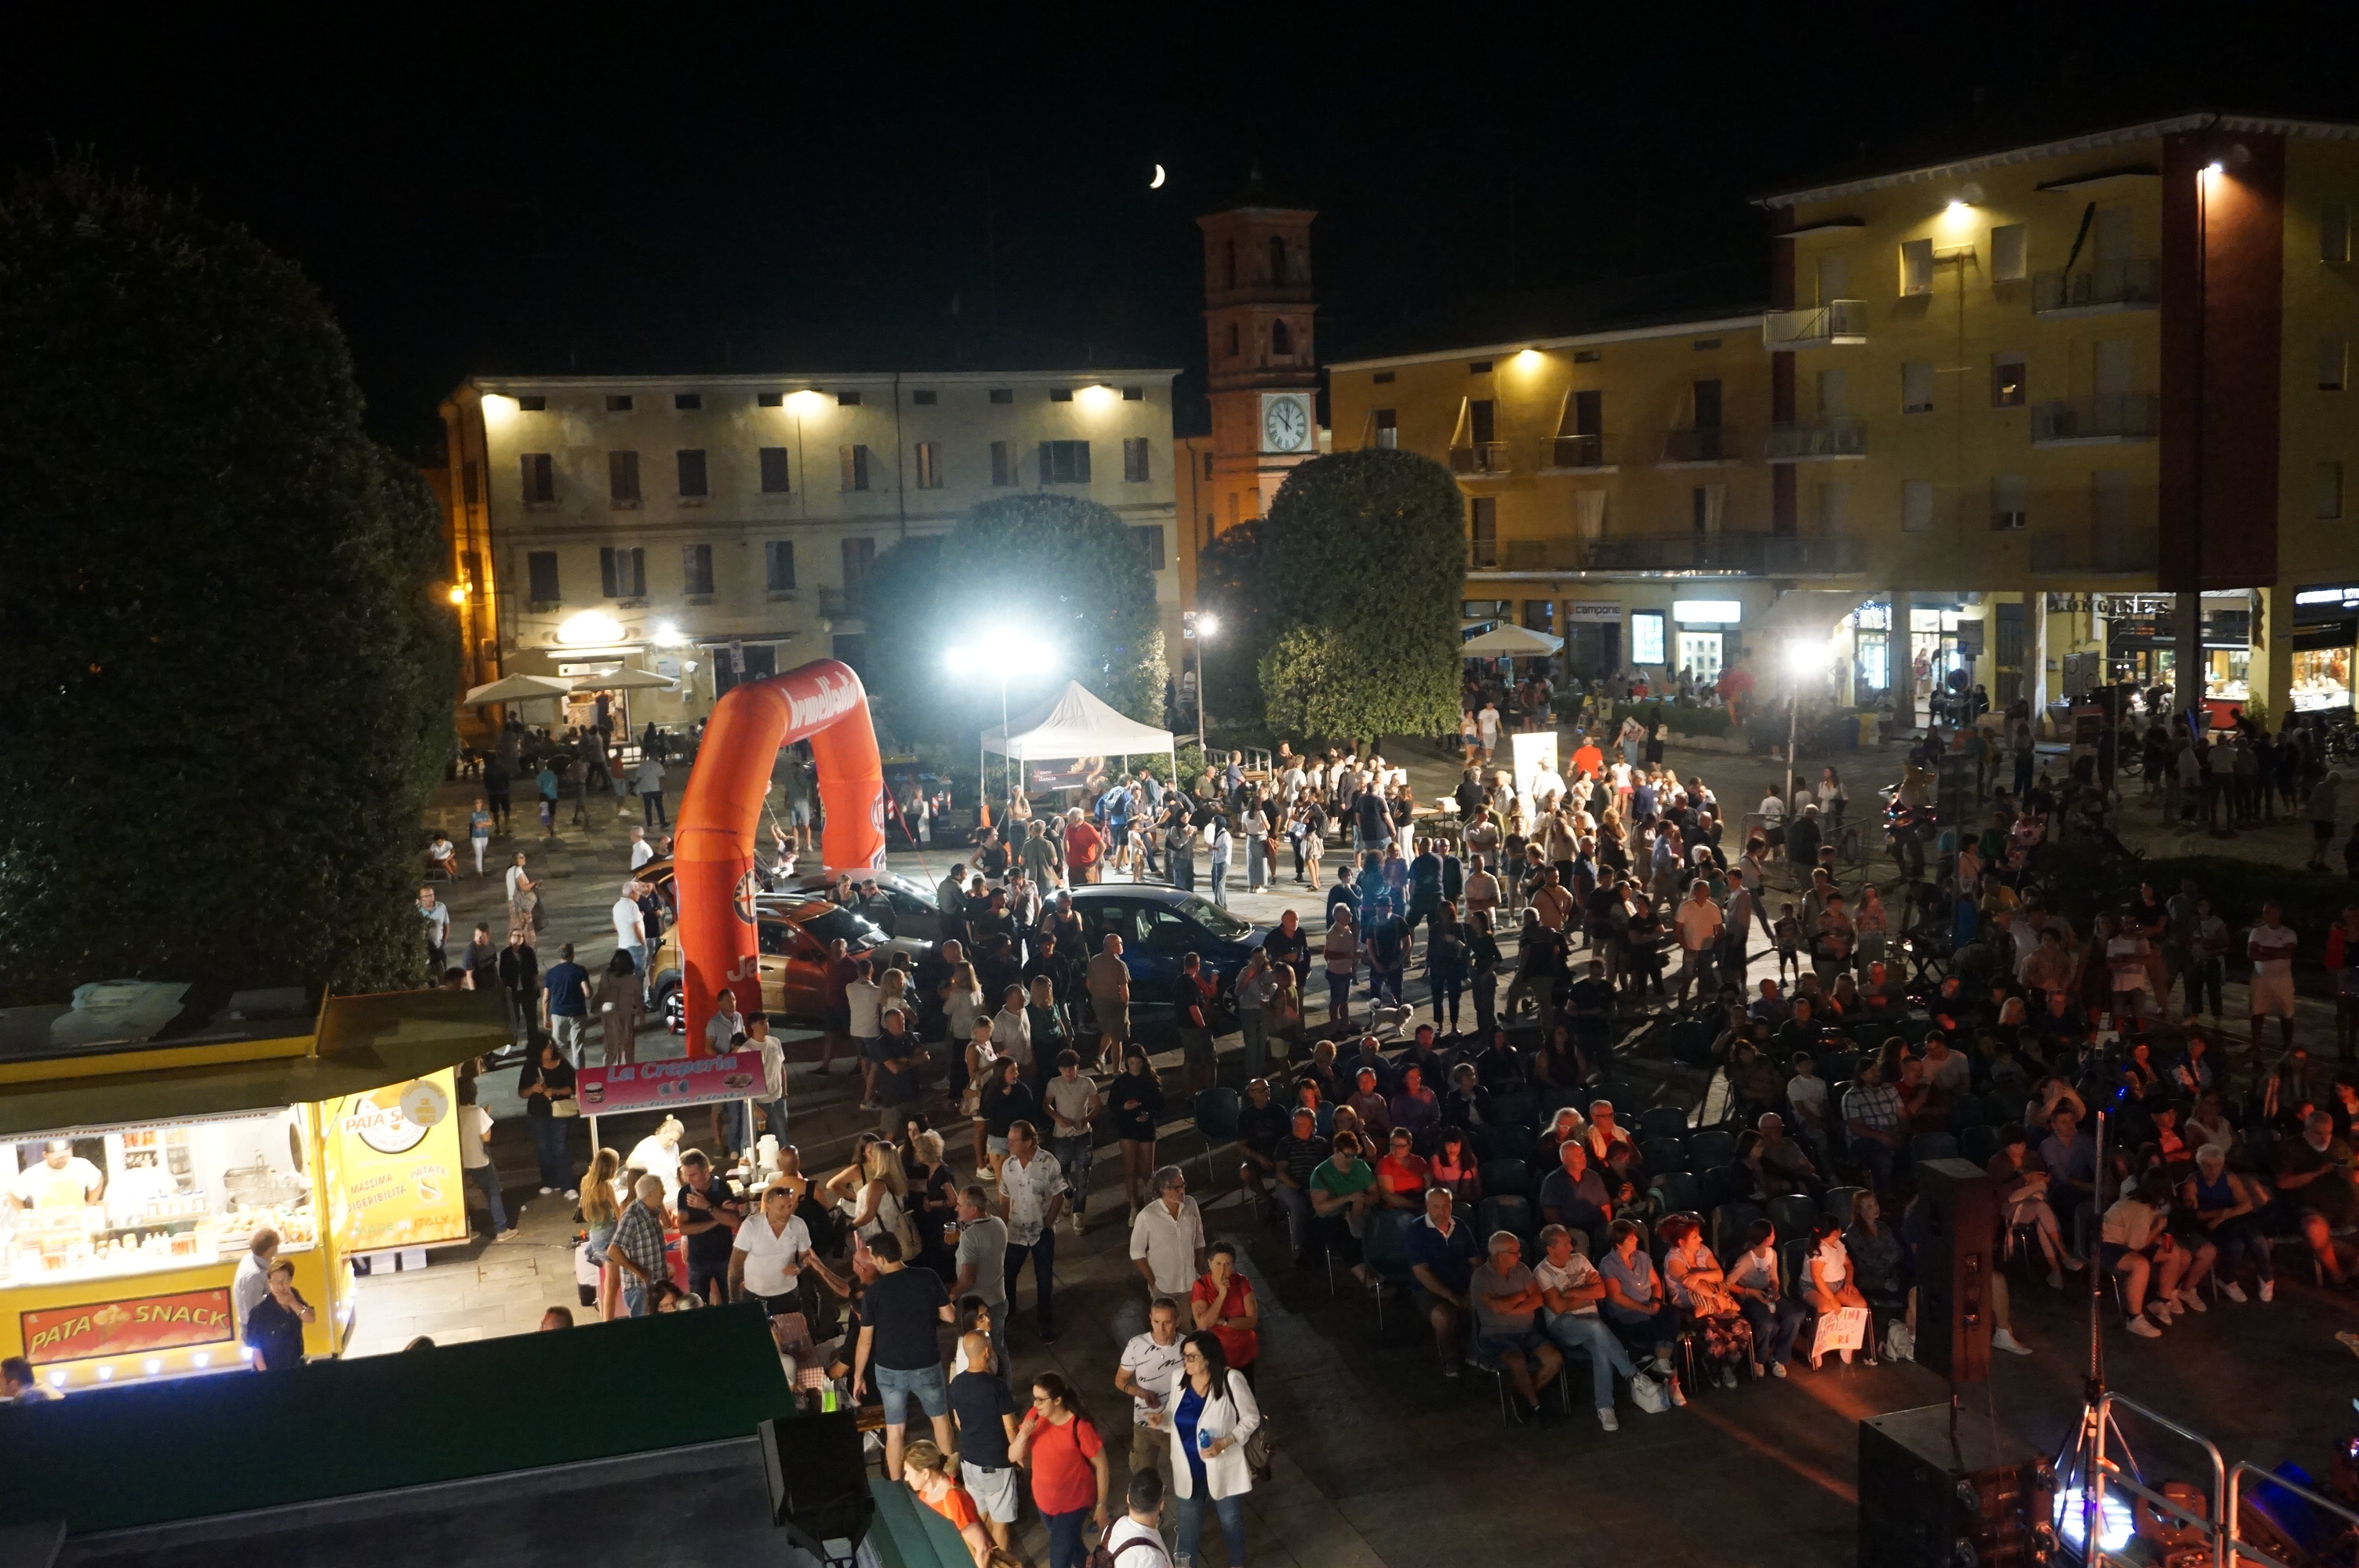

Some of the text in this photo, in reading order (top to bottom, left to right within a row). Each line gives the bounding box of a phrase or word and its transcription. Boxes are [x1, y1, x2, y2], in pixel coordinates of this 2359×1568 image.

[607, 1054, 737, 1082] La Creperia
[345, 1112, 385, 1132] PATA
[410, 1165, 448, 1179] PATATE
[351, 1174, 393, 1195] MASSIMA
[354, 1221, 394, 1236] MADE
[413, 1214, 449, 1228] ITALY
[29, 1305, 229, 1355] PATA SNACK
